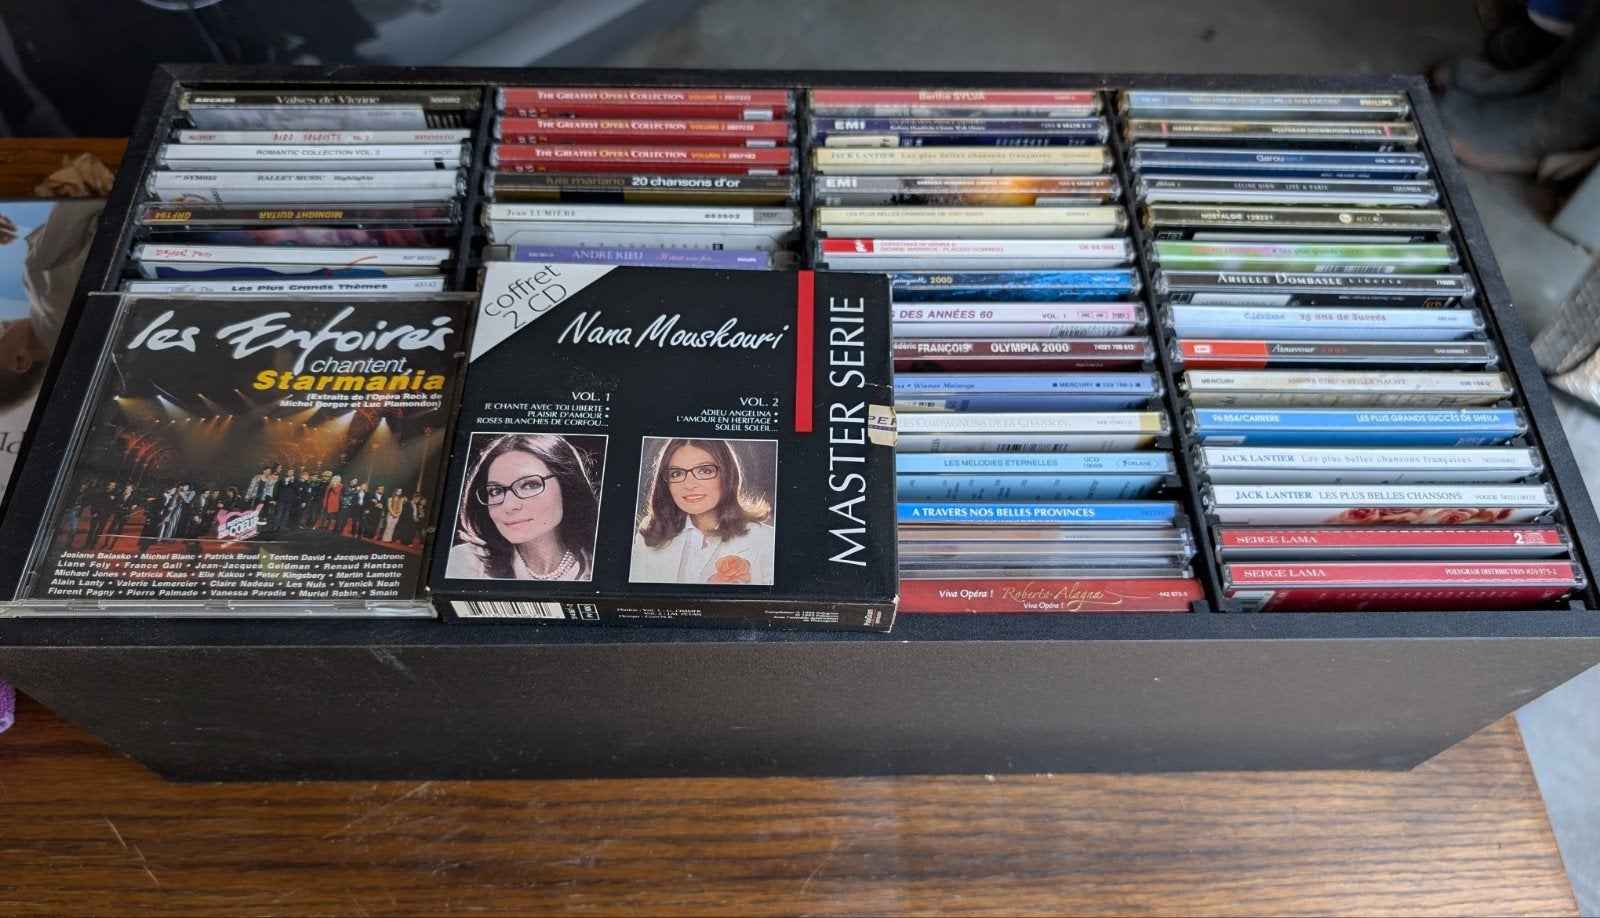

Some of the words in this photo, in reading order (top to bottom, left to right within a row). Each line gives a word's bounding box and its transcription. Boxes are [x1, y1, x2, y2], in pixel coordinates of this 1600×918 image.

[538, 90, 554, 100] THE
[556, 91, 598, 100] GREATEST
[600, 91, 628, 100] OPERA
[630, 91, 685, 101] COLLECTION
[919, 91, 951, 101] Berthe
[953, 91, 986, 101] SYLVA
[834, 120, 866, 130] EMI
[632, 176, 648, 186] 20
[650, 177, 712, 187] chansons
[714, 178, 741, 188] d'or
[615, 251, 643, 261] RIEU
[1217, 272, 1270, 284] ARIELLE
[1275, 273, 1343, 285] DOMBASLE
[289, 284, 334, 292] Grands
[338, 282, 389, 290] Thèmes
[484, 264, 562, 317] coffret
[502, 310, 527, 330] 2
[528, 283, 567, 313] CD
[900, 310, 923, 319] DES
[928, 308, 976, 319] ANNÉES
[979, 310, 994, 319] 60
[127, 310, 201, 352] les
[557, 310, 633, 346] Nana
[634, 313, 790, 350] Mouskouri
[828, 297, 866, 389] SERIE
[1271, 343, 1316, 353] Aznavour
[917, 343, 969, 355] FRANÇOIS
[991, 342, 1040, 353] OLYMPIA
[1041, 342, 1070, 353] 2000
[310, 356, 408, 373] chantent
[252, 369, 446, 391] Starmania
[306, 393, 350, 401] (Extraits
[351, 393, 364, 401] de
[366, 393, 401, 402] l'Opéra
[402, 393, 428, 401] Rock
[430, 393, 443, 401] de
[571, 391, 601, 401] VOL.
[605, 392, 611, 402] 1
[279, 400, 313, 408] Michel
[316, 400, 348, 409] Berger
[383, 401, 442, 409] Plamondon)
[740, 397, 769, 407] VOL.
[772, 397, 779, 407] 2
[493, 403, 530, 411] CHANTE
[530, 403, 554, 411] AVEC
[571, 404, 603, 412] LIBERTE
[527, 410, 558, 418] PLAISIR
[559, 411, 603, 419] D'AMOUR
[1356, 414, 1370, 422] LES
[1370, 414, 1390, 422] PLUS
[1391, 414, 1426, 422] GRANDS
[1461, 414, 1472, 422] DE
[1472, 414, 1499, 422] SHEILA
[476, 417, 503, 425] ROSES
[550, 418, 562, 426] DE
[676, 415, 716, 423] L'AMOUR
[731, 416, 772, 425] HERITAGE
[715, 423, 742, 431] SOLEIL
[961, 458, 1004, 467] MÉLODIES
[1005, 459, 1058, 467] ÉTERNELLES
[1220, 454, 1248, 463] JACK
[1250, 454, 1295, 463] LANTIER
[1301, 455, 1319, 463] Les
[1322, 455, 1342, 464] plus
[1344, 455, 1374, 463] belles
[1376, 455, 1419, 463] chansons
[1423, 455, 1472, 465] françaises
[828, 402, 867, 567] MASTER
[1235, 491, 1262, 500] JACK
[1265, 491, 1313, 500] LANTIER
[1318, 491, 1340, 500] LES
[1342, 491, 1364, 500] PLUS
[1367, 491, 1405, 500] BELLES
[1406, 491, 1462, 501] CHANSONS
[912, 508, 920, 517] A
[921, 508, 967, 517] TRAVERS
[969, 508, 994, 517] NOS
[996, 508, 1031, 517] BELLES
[1034, 508, 1095, 518] PROVINCES
[1236, 536, 1279, 544] SERGE
[1281, 536, 1318, 544] LAMA
[1513, 532, 1525, 544] 2
[61, 551, 95, 559] Josiane
[97, 552, 132, 560] Balasko
[237, 553, 260, 561] Bruel
[269, 553, 299, 561] Tonton
[334, 554, 369, 562] Jacques
[57, 560, 85, 568] Liane
[89, 561, 111, 570] Foly
[195, 562, 264, 571] Jean-Jacques
[267, 562, 311, 570] Goldman
[363, 562, 404, 570] Hantson
[47, 587, 82, 595] Florent
[86, 588, 115, 597] Pagny
[126, 589, 155, 597] Pierre
[158, 589, 199, 597] Palmade
[210, 589, 249, 597] Vanessa
[251, 589, 287, 597] Paradis
[299, 589, 329, 597] Muriel
[332, 589, 358, 597] Robin
[369, 589, 399, 597] Smain
[939, 589, 958, 598] Viva
[960, 588, 988, 599] Opéra
